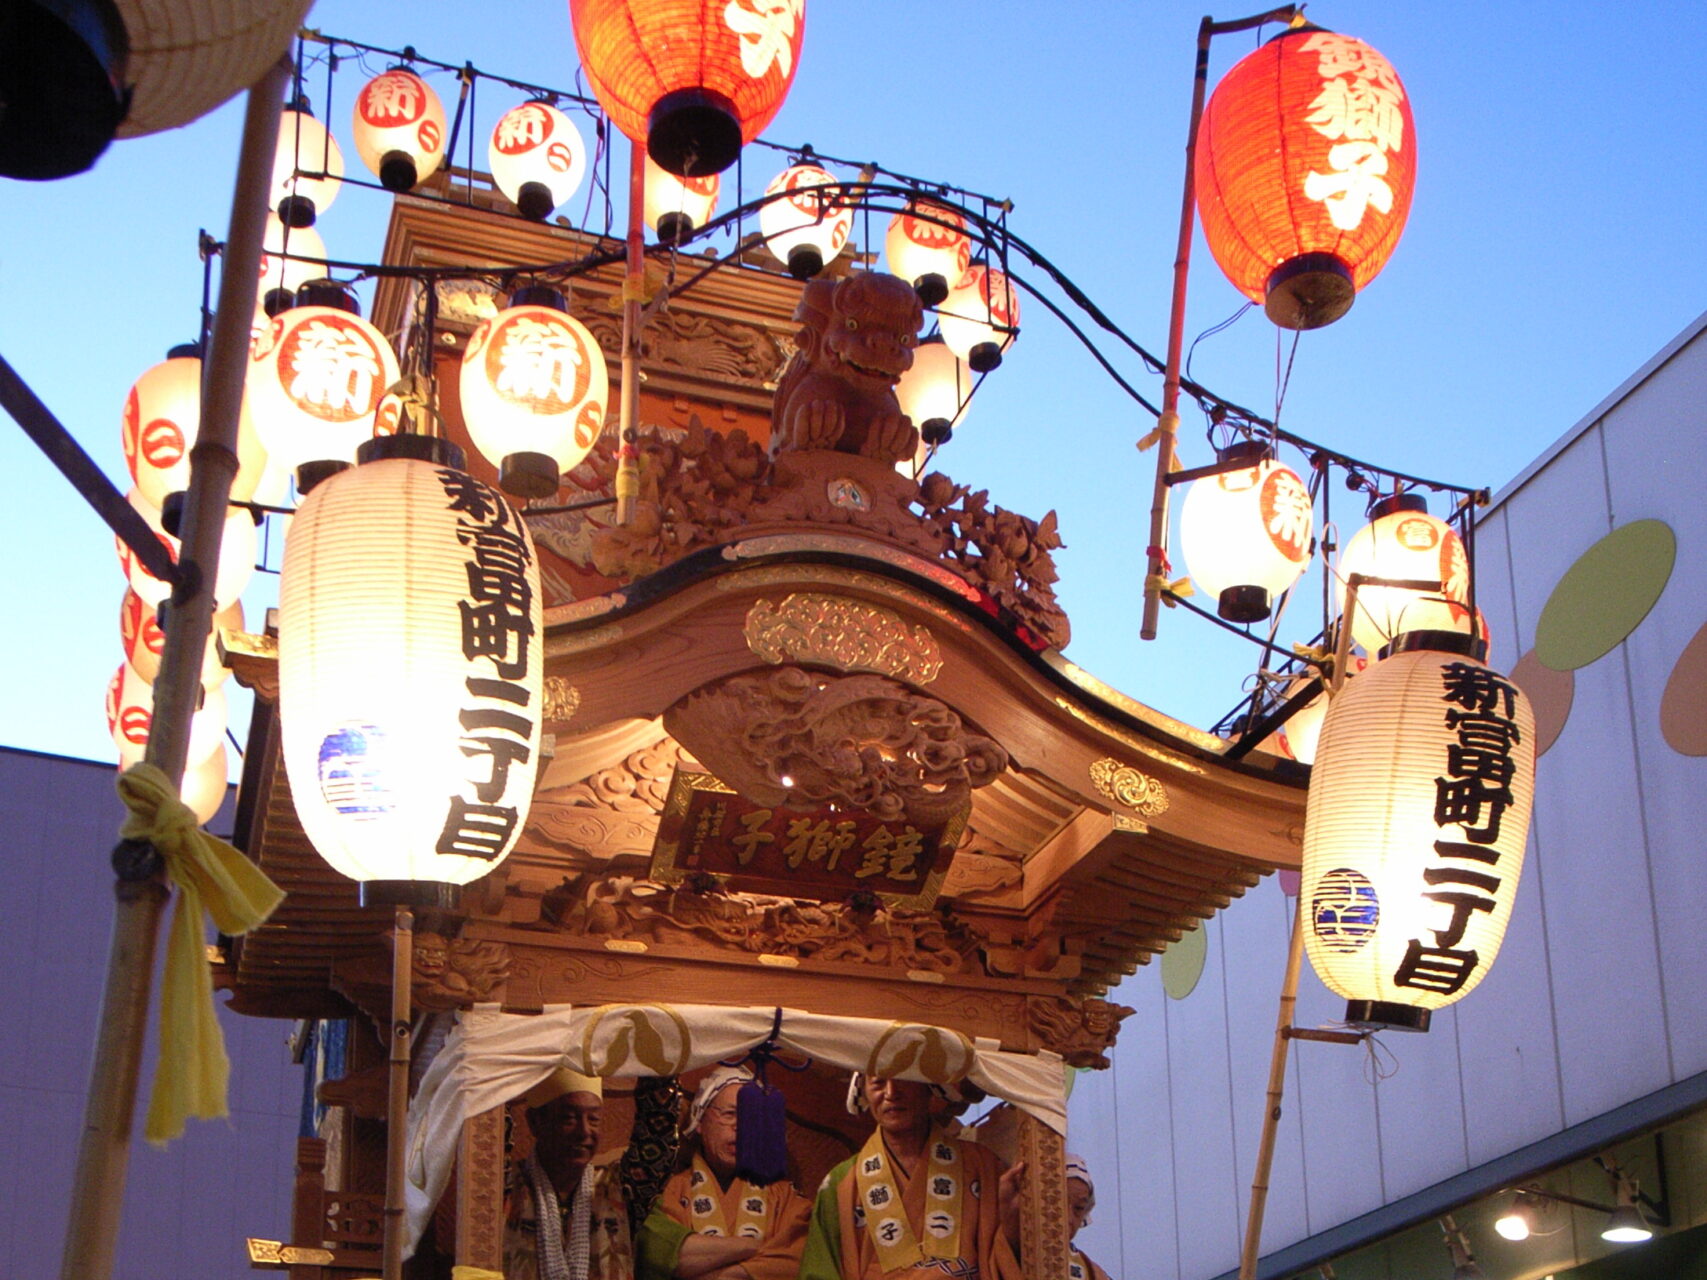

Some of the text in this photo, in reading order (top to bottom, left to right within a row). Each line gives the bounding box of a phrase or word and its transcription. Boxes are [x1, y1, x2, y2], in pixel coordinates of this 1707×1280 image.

[367, 75, 420, 120] 新
[498, 107, 546, 150] 新
[1297, 32, 1404, 230] 鏡獅子
[290, 320, 380, 415] 新
[496, 317, 583, 404] 新
[436, 468, 536, 862] 新富町二丁目
[1394, 661, 1521, 997] 新富町二丁目
[930, 1143, 953, 1231] 新富二
